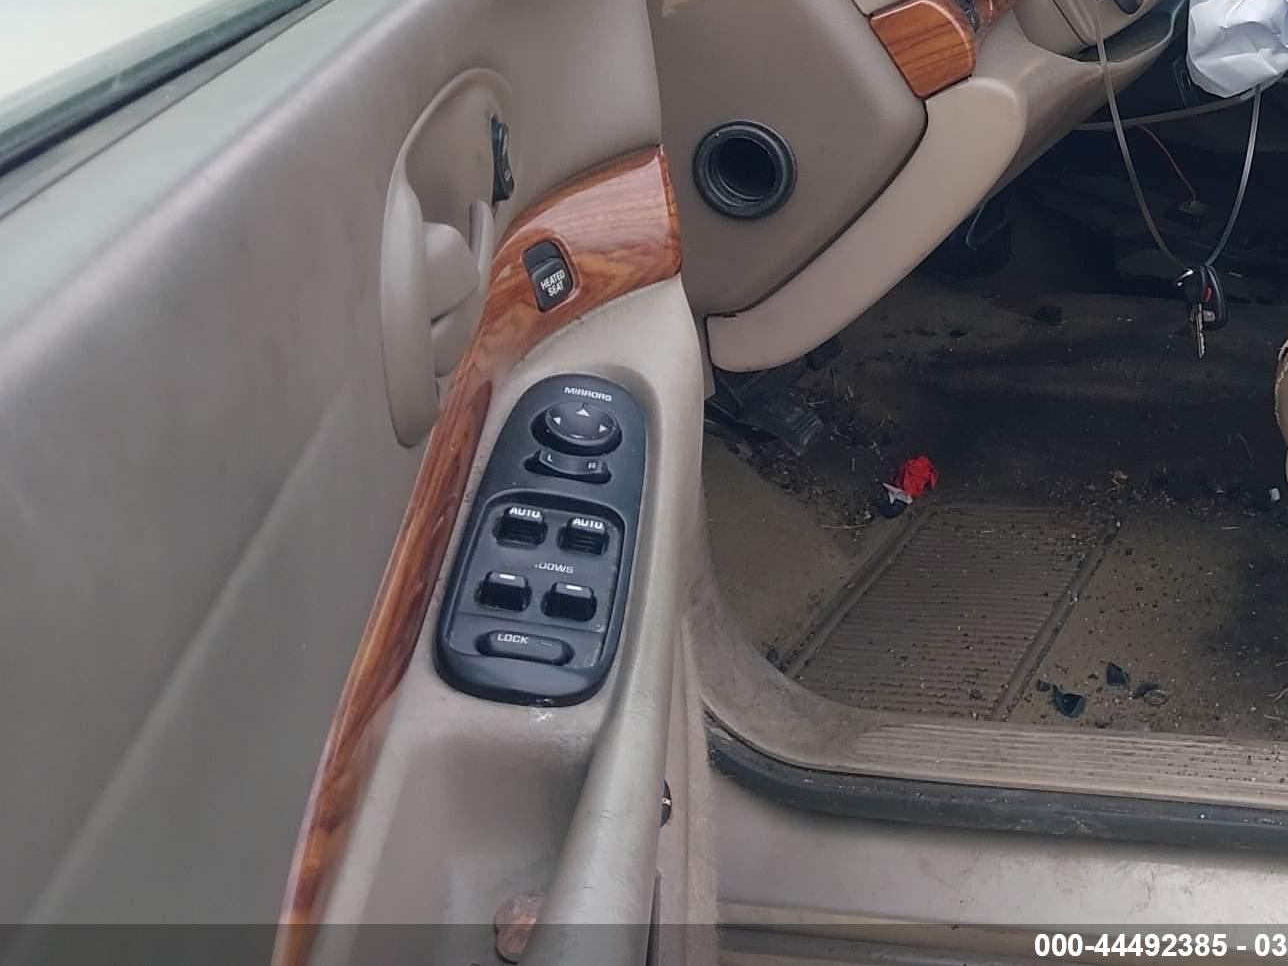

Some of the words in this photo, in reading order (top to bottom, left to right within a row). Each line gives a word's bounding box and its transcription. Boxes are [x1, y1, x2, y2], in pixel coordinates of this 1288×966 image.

[540, 269, 565, 290] HEATED
[548, 280, 564, 297] SEAT
[564, 386, 613, 402] MIRRORS
[547, 454, 553, 463] L
[587, 461, 597, 470] R
[509, 506, 541, 519] AUTO
[572, 517, 604, 530] AUTO
[497, 633, 529, 644] LOCK
